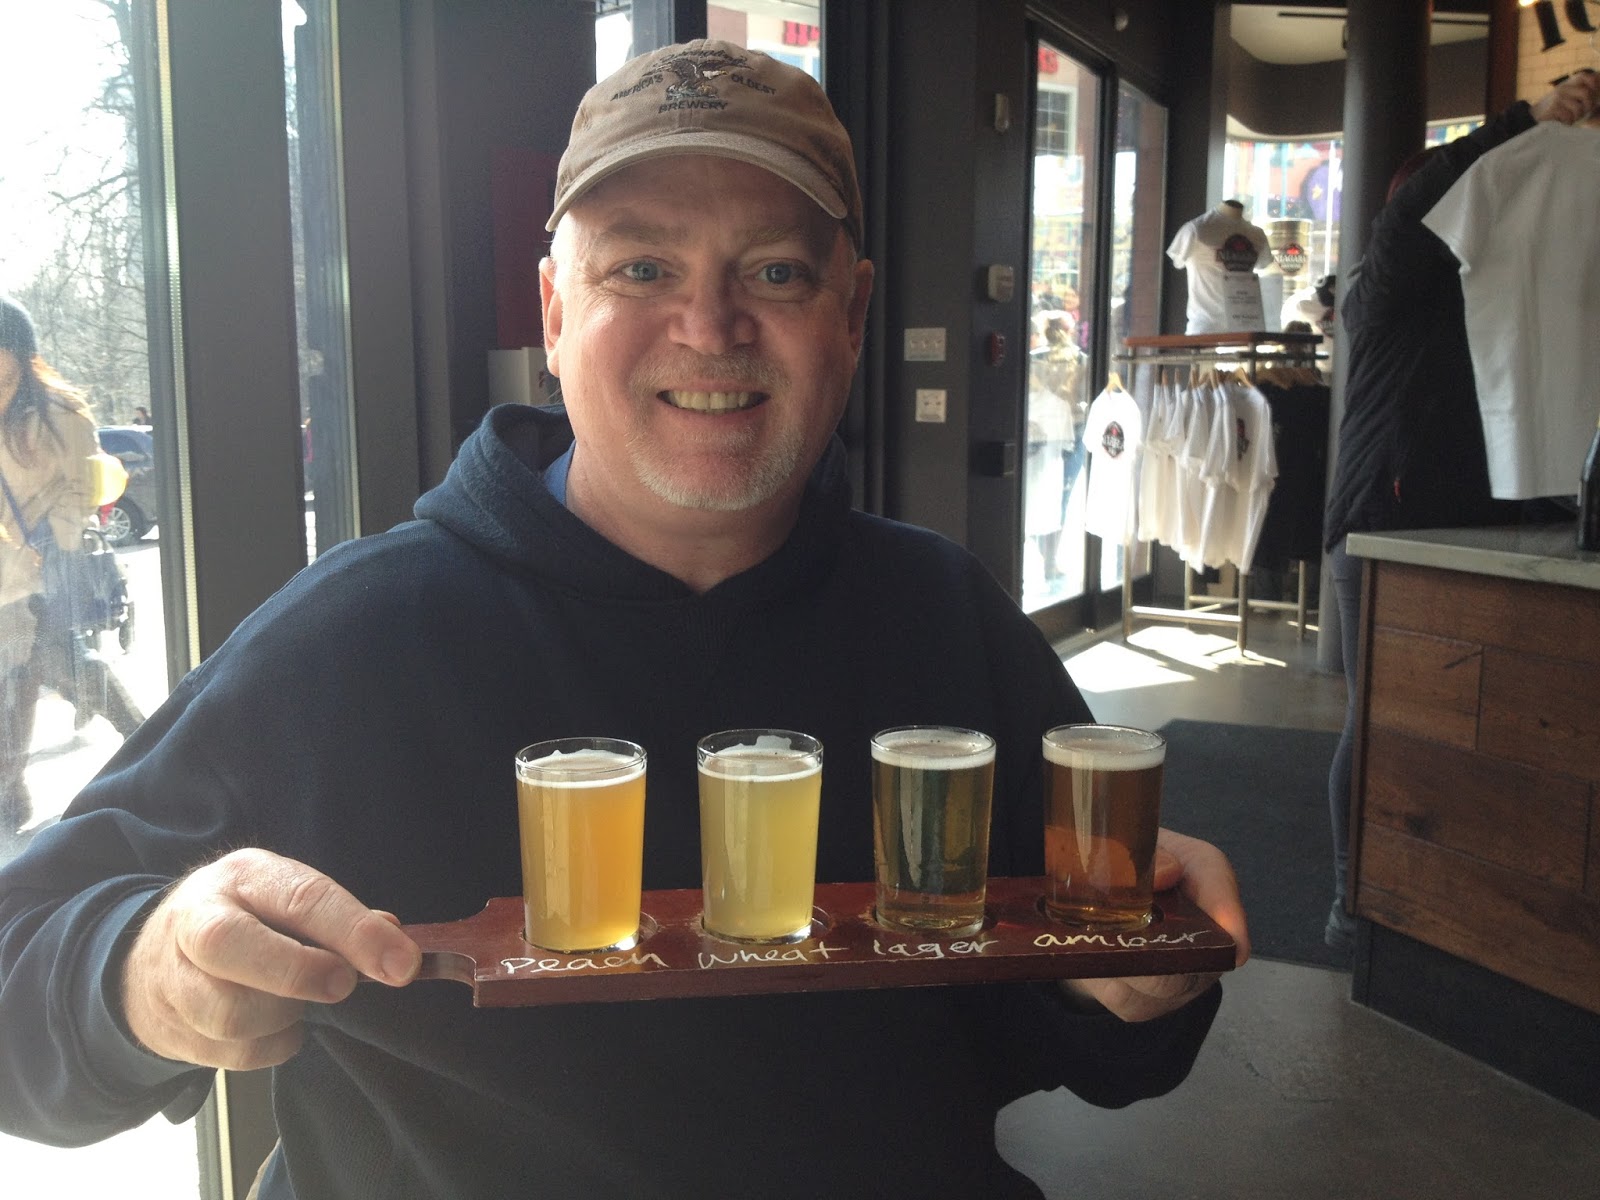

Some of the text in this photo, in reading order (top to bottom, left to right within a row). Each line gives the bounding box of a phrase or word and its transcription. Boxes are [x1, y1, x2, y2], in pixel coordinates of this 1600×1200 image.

[610, 73, 777, 101] AMERICA'S OLDEST
[658, 101, 728, 114] BREWERY
[1033, 929, 1213, 948] amber
